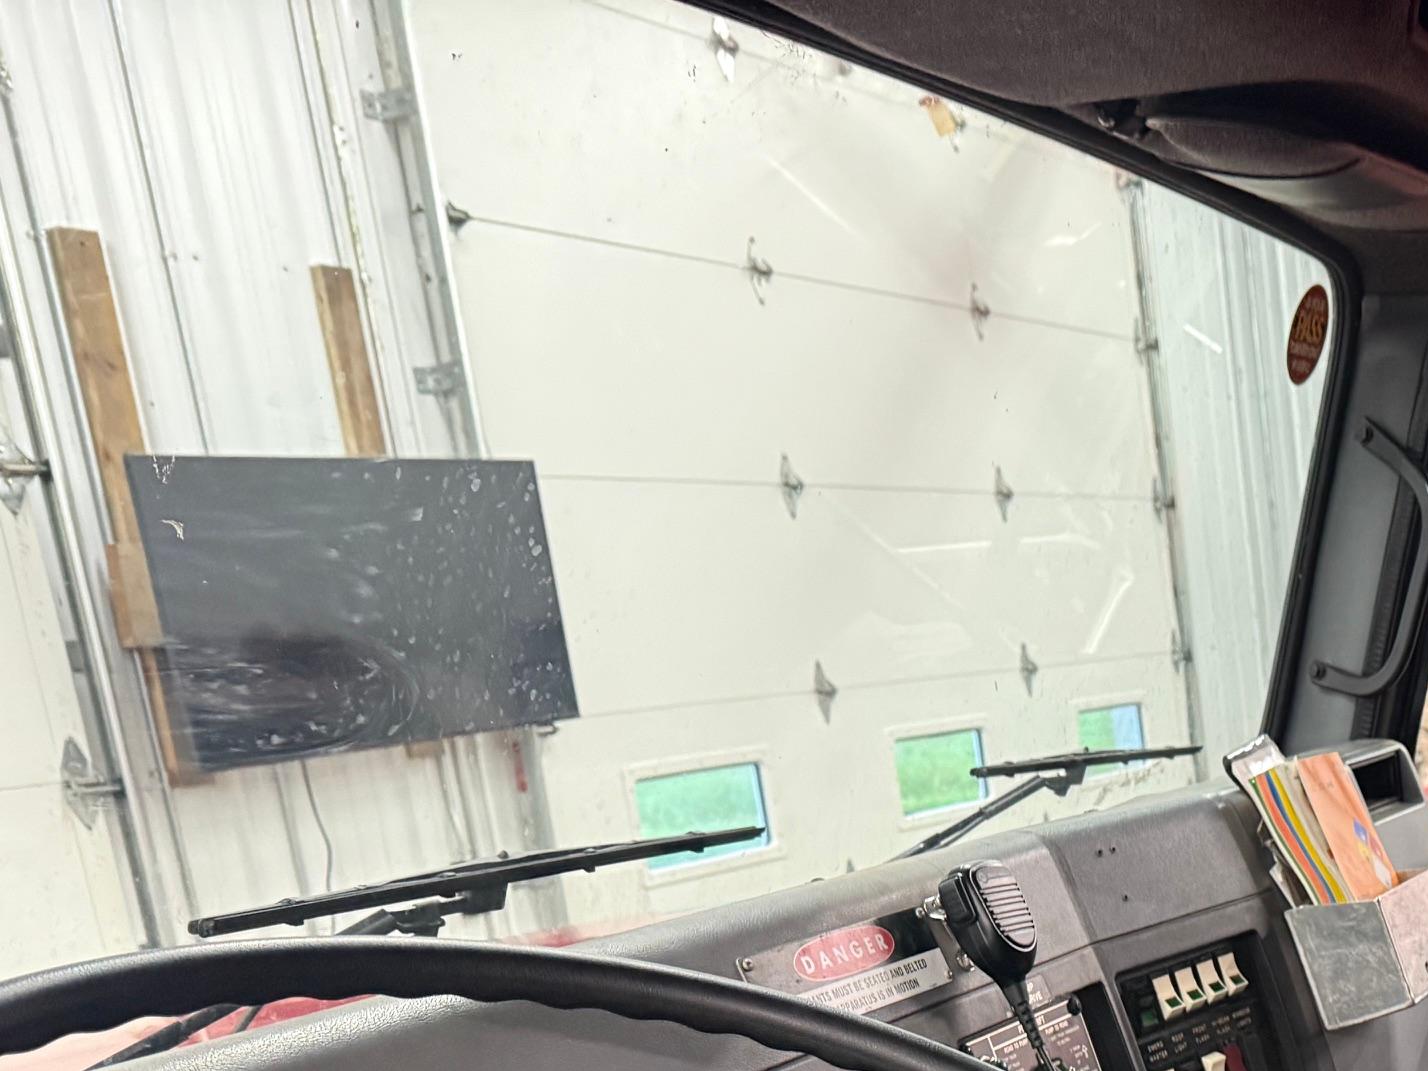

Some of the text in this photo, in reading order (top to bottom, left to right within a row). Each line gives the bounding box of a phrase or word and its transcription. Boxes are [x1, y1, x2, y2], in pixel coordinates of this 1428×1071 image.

[801, 934, 888, 975] DANGER
[832, 982, 855, 1000] MUST
[855, 980, 865, 992] BE
[863, 972, 891, 989] SEATED
[889, 966, 904, 979] AND
[903, 958, 928, 976] BELTED
[878, 991, 887, 1001] IS
[885, 987, 895, 998] IN
[894, 977, 920, 995] MOTION
